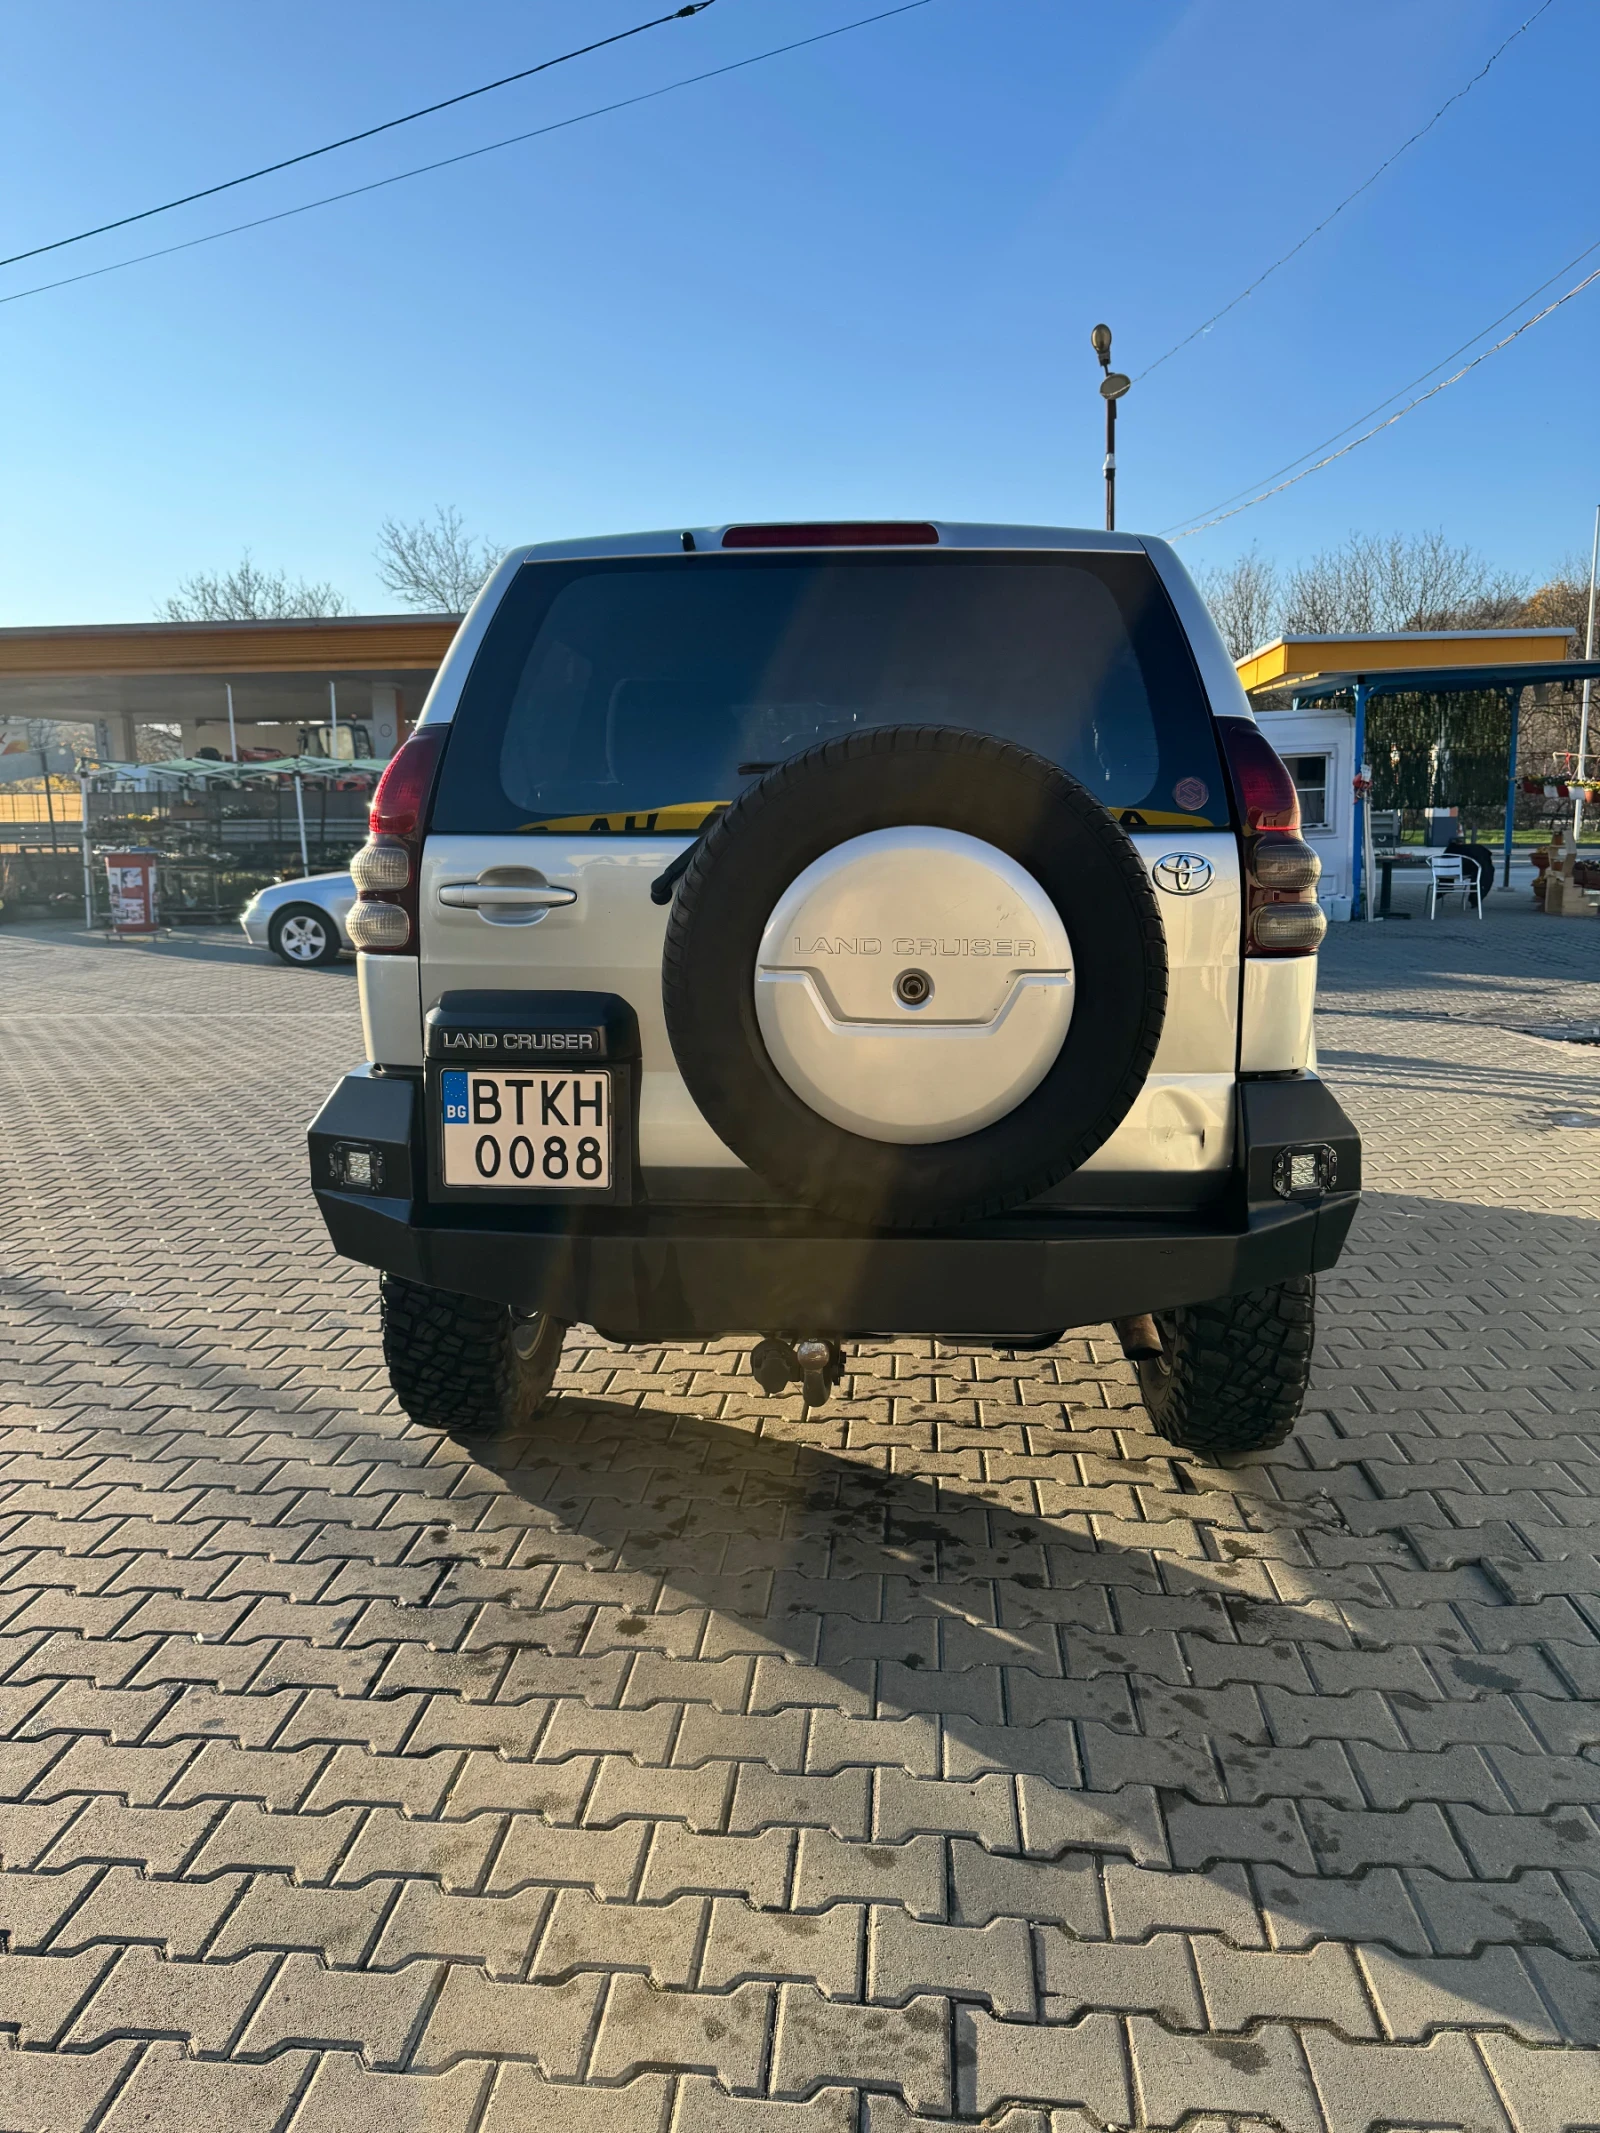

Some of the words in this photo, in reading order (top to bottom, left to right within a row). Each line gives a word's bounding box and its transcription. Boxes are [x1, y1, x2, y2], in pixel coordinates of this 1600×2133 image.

[794, 936, 882, 955] LAND
[891, 937, 1037, 957] CRUISER
[443, 1032, 498, 1049] LAND
[503, 1033, 593, 1050] CRUISER
[447, 1105, 467, 1119] BG
[472, 1079, 603, 1127] BTKH
[475, 1134, 603, 1181] 0088
